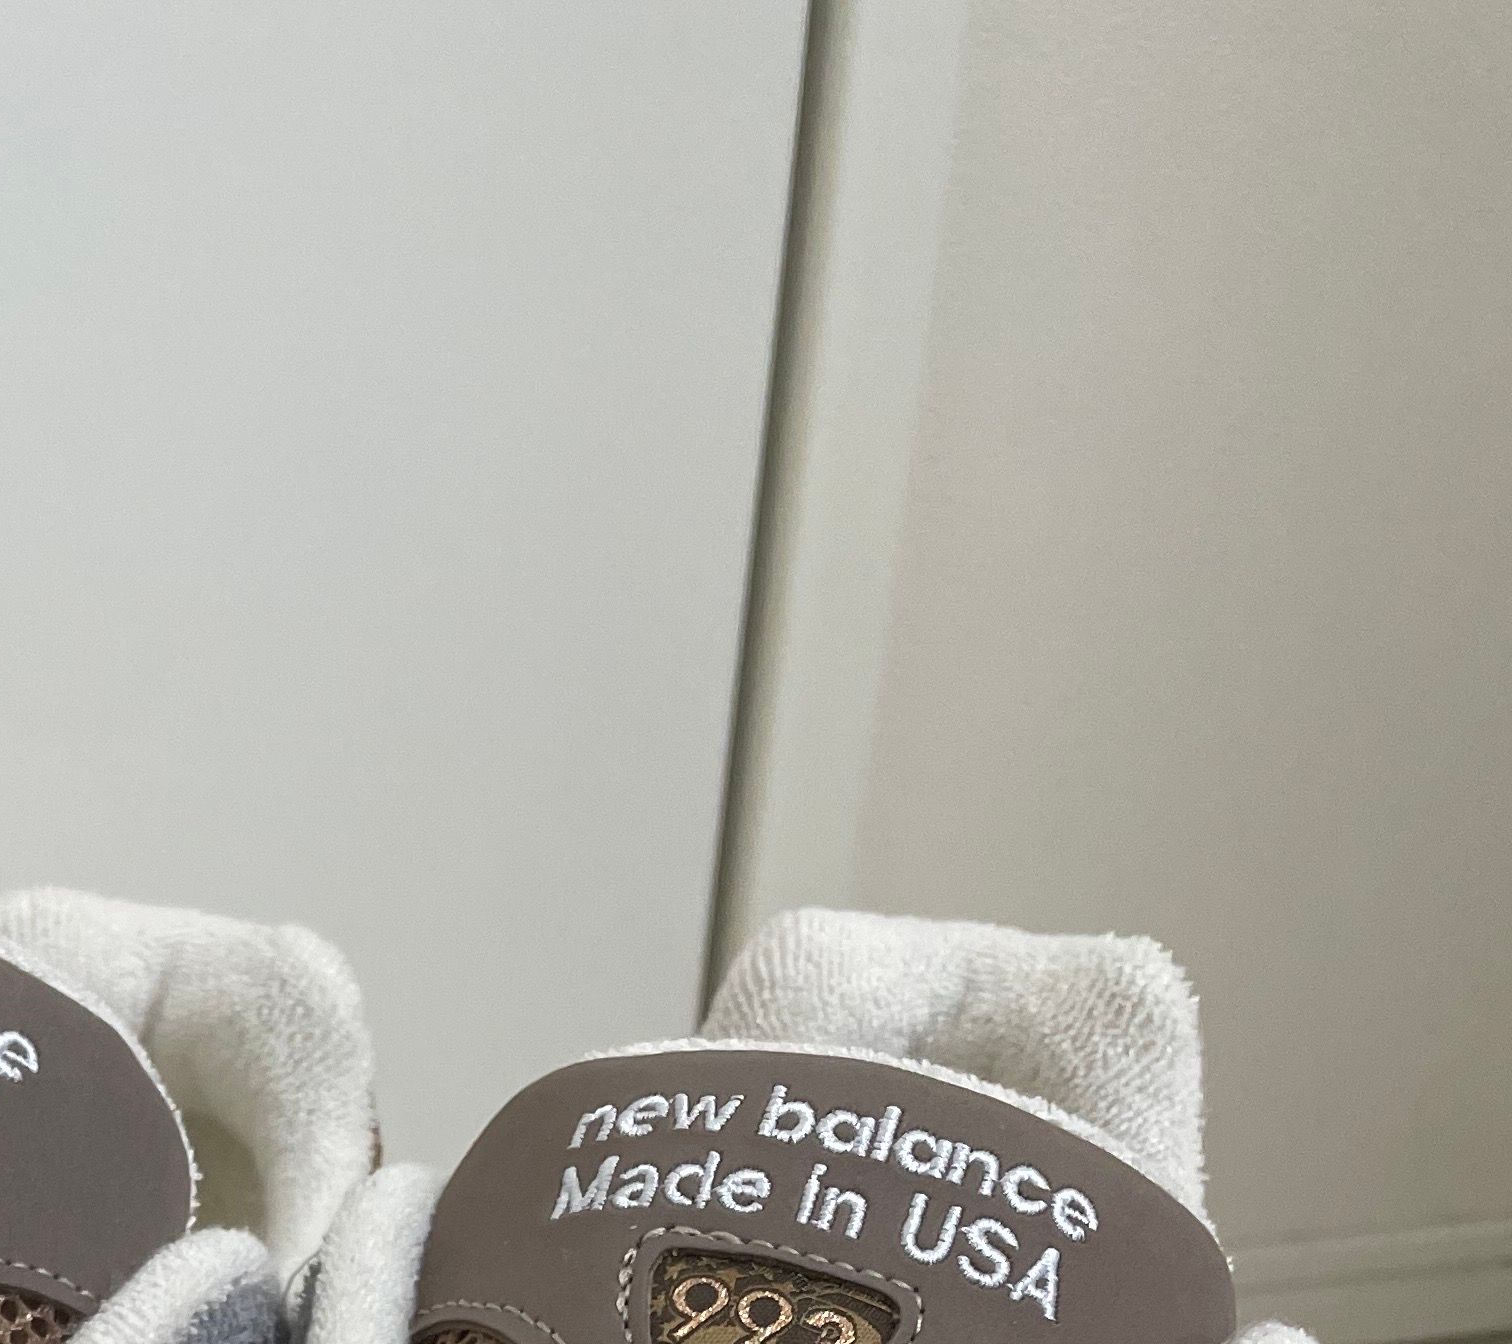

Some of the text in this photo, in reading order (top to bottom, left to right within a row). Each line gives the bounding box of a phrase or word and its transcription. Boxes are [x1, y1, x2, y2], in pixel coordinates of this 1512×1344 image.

[550, 1151, 1062, 1322] Made in USA
[567, 1085, 1098, 1241] new balance
